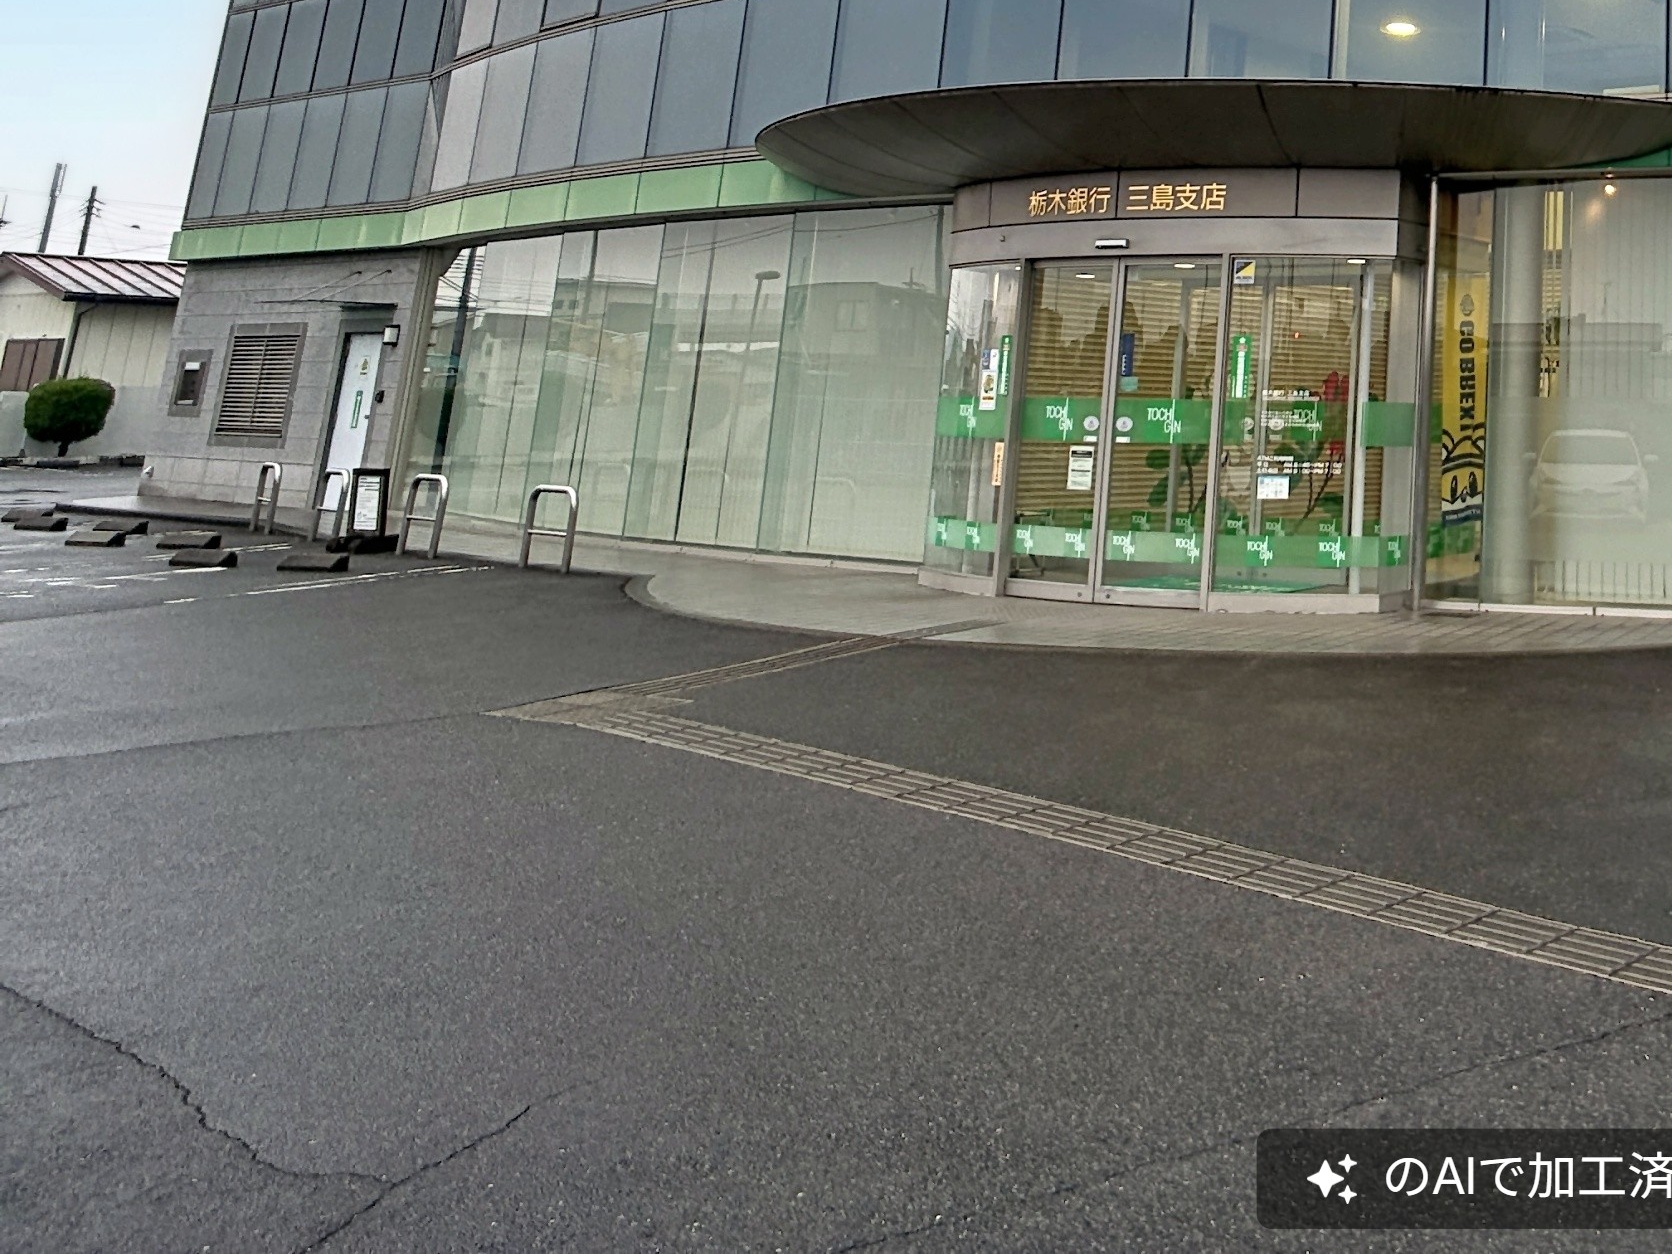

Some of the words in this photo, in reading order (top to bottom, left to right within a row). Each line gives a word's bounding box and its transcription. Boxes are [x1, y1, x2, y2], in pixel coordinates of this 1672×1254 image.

[1029, 186, 1111, 217] 栃木銀行
[1126, 182, 1227, 211] 三島支店
[1046, 406, 1066, 419] TOCH
[1147, 407, 1172, 421] TOCH
[1247, 541, 1267, 551] TOCH
[1319, 542, 1339, 552] TOCH
